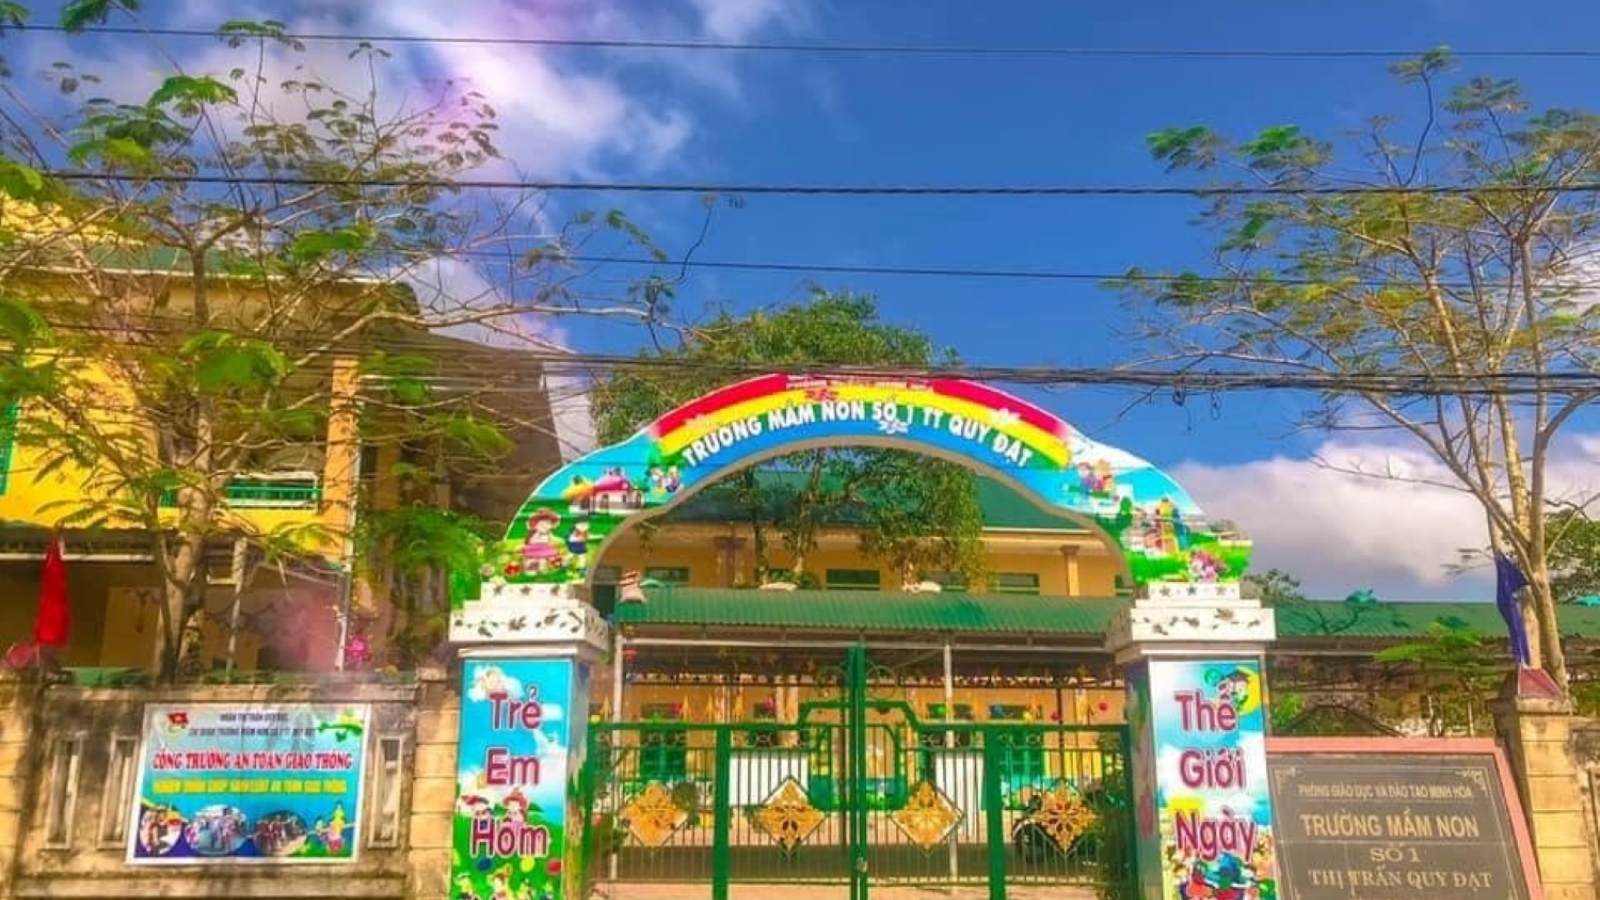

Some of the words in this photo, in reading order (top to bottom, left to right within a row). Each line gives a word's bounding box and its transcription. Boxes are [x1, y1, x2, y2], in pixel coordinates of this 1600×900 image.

[822, 401, 865, 421] NON
[489, 685, 542, 729] Trẻ
[486, 748, 540, 786] Em
[1179, 747, 1244, 788] Giới
[1175, 808, 1256, 862] Ngày
[1299, 808, 1382, 836] TRƯỜNG
[1436, 815, 1480, 838] NON
[1409, 848, 1421, 862] 1
[1348, 864, 1402, 887] TRẤN
[1453, 872, 1493, 891] ĐẠT
